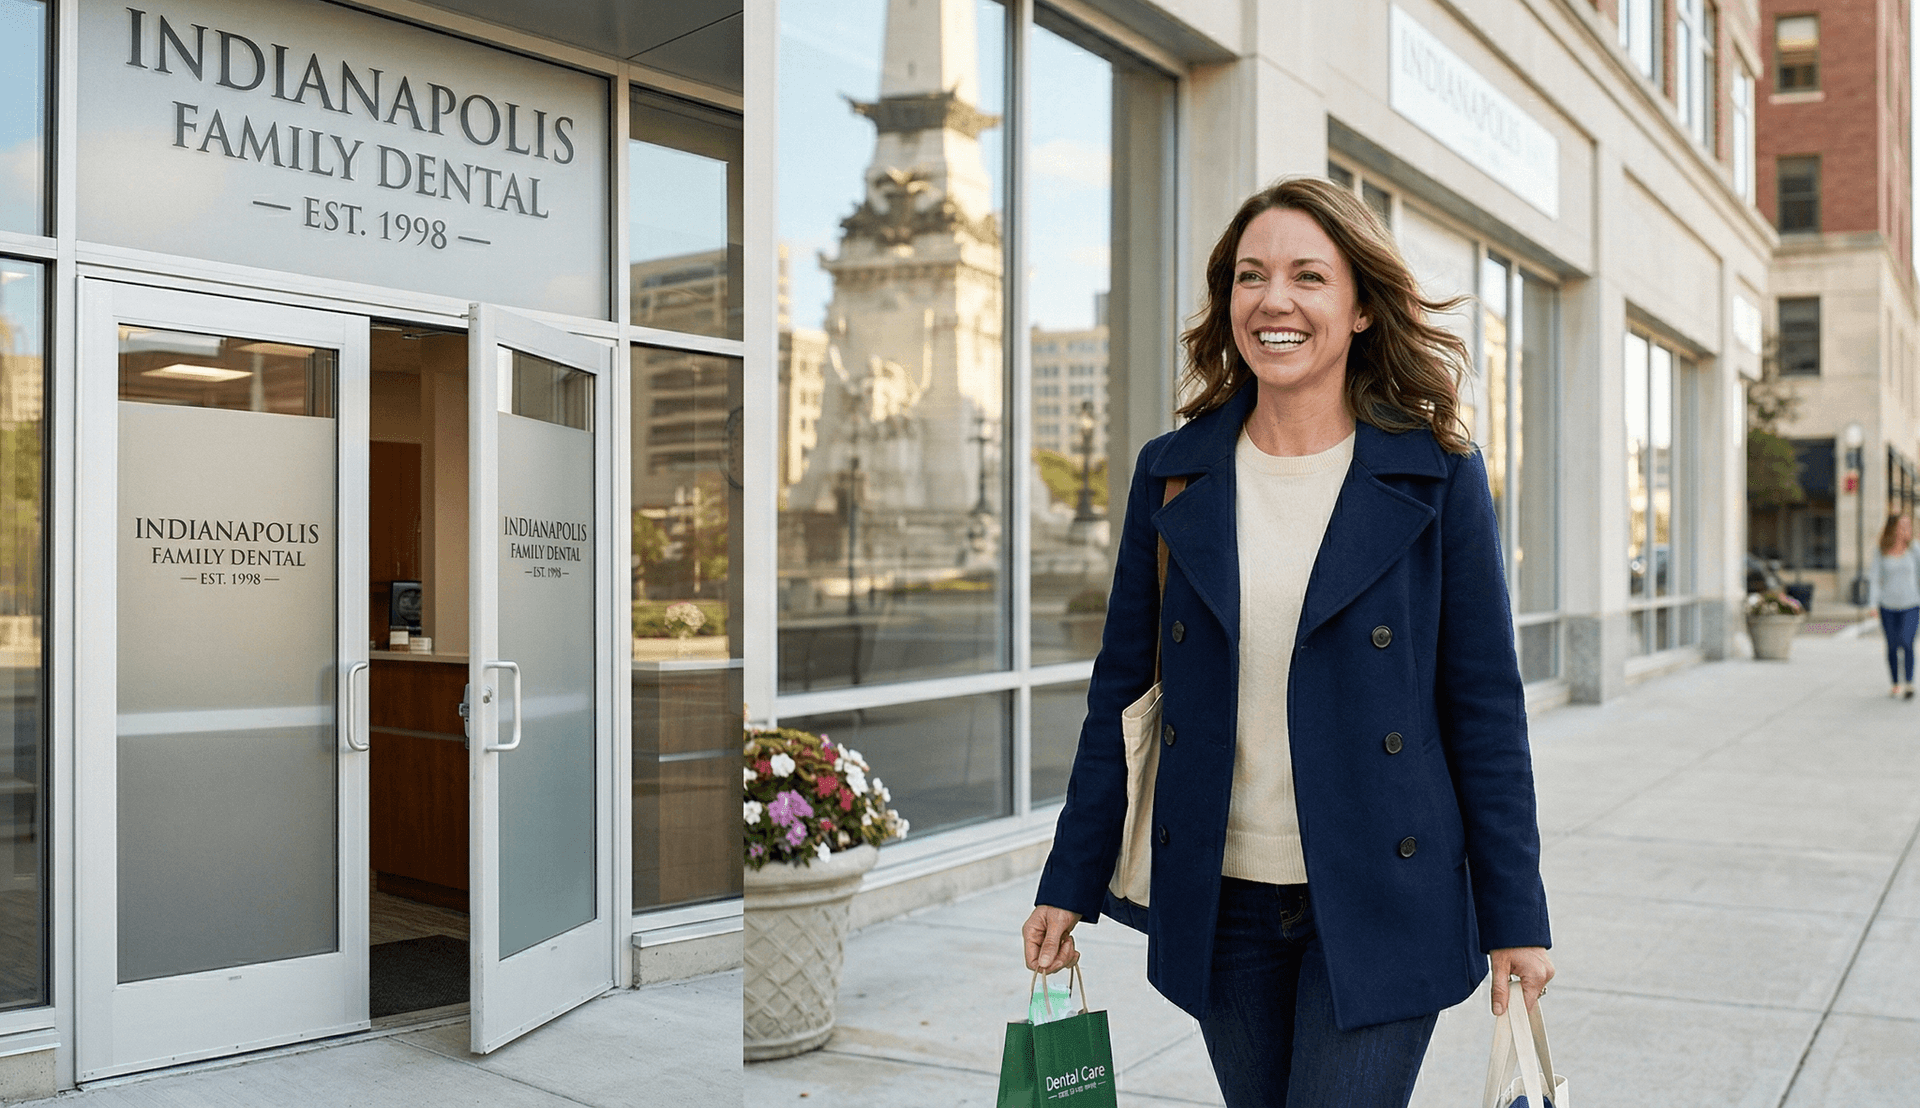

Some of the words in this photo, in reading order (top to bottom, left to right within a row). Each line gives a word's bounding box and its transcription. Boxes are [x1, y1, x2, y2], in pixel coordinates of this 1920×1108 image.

[126, 6, 575, 165] INDIANAPOLIS
[172, 100, 364, 181] FAMILY
[376, 144, 549, 219] DENTAL
[303, 196, 367, 236] EST.
[379, 210, 448, 250] 1998
[135, 517, 320, 544] INDIANAPOLIS
[504, 516, 587, 542] INDIANAPOLIS
[152, 547, 225, 565] FAMILY
[231, 549, 306, 567] DENTAL
[511, 543, 545, 559] FAMILY
[547, 545, 581, 561] DENTAL
[200, 573, 227, 585] EST.
[231, 573, 261, 585] 1998
[1046, 1068, 1079, 1091] Dental
[1081, 1065, 1105, 1081] Care
